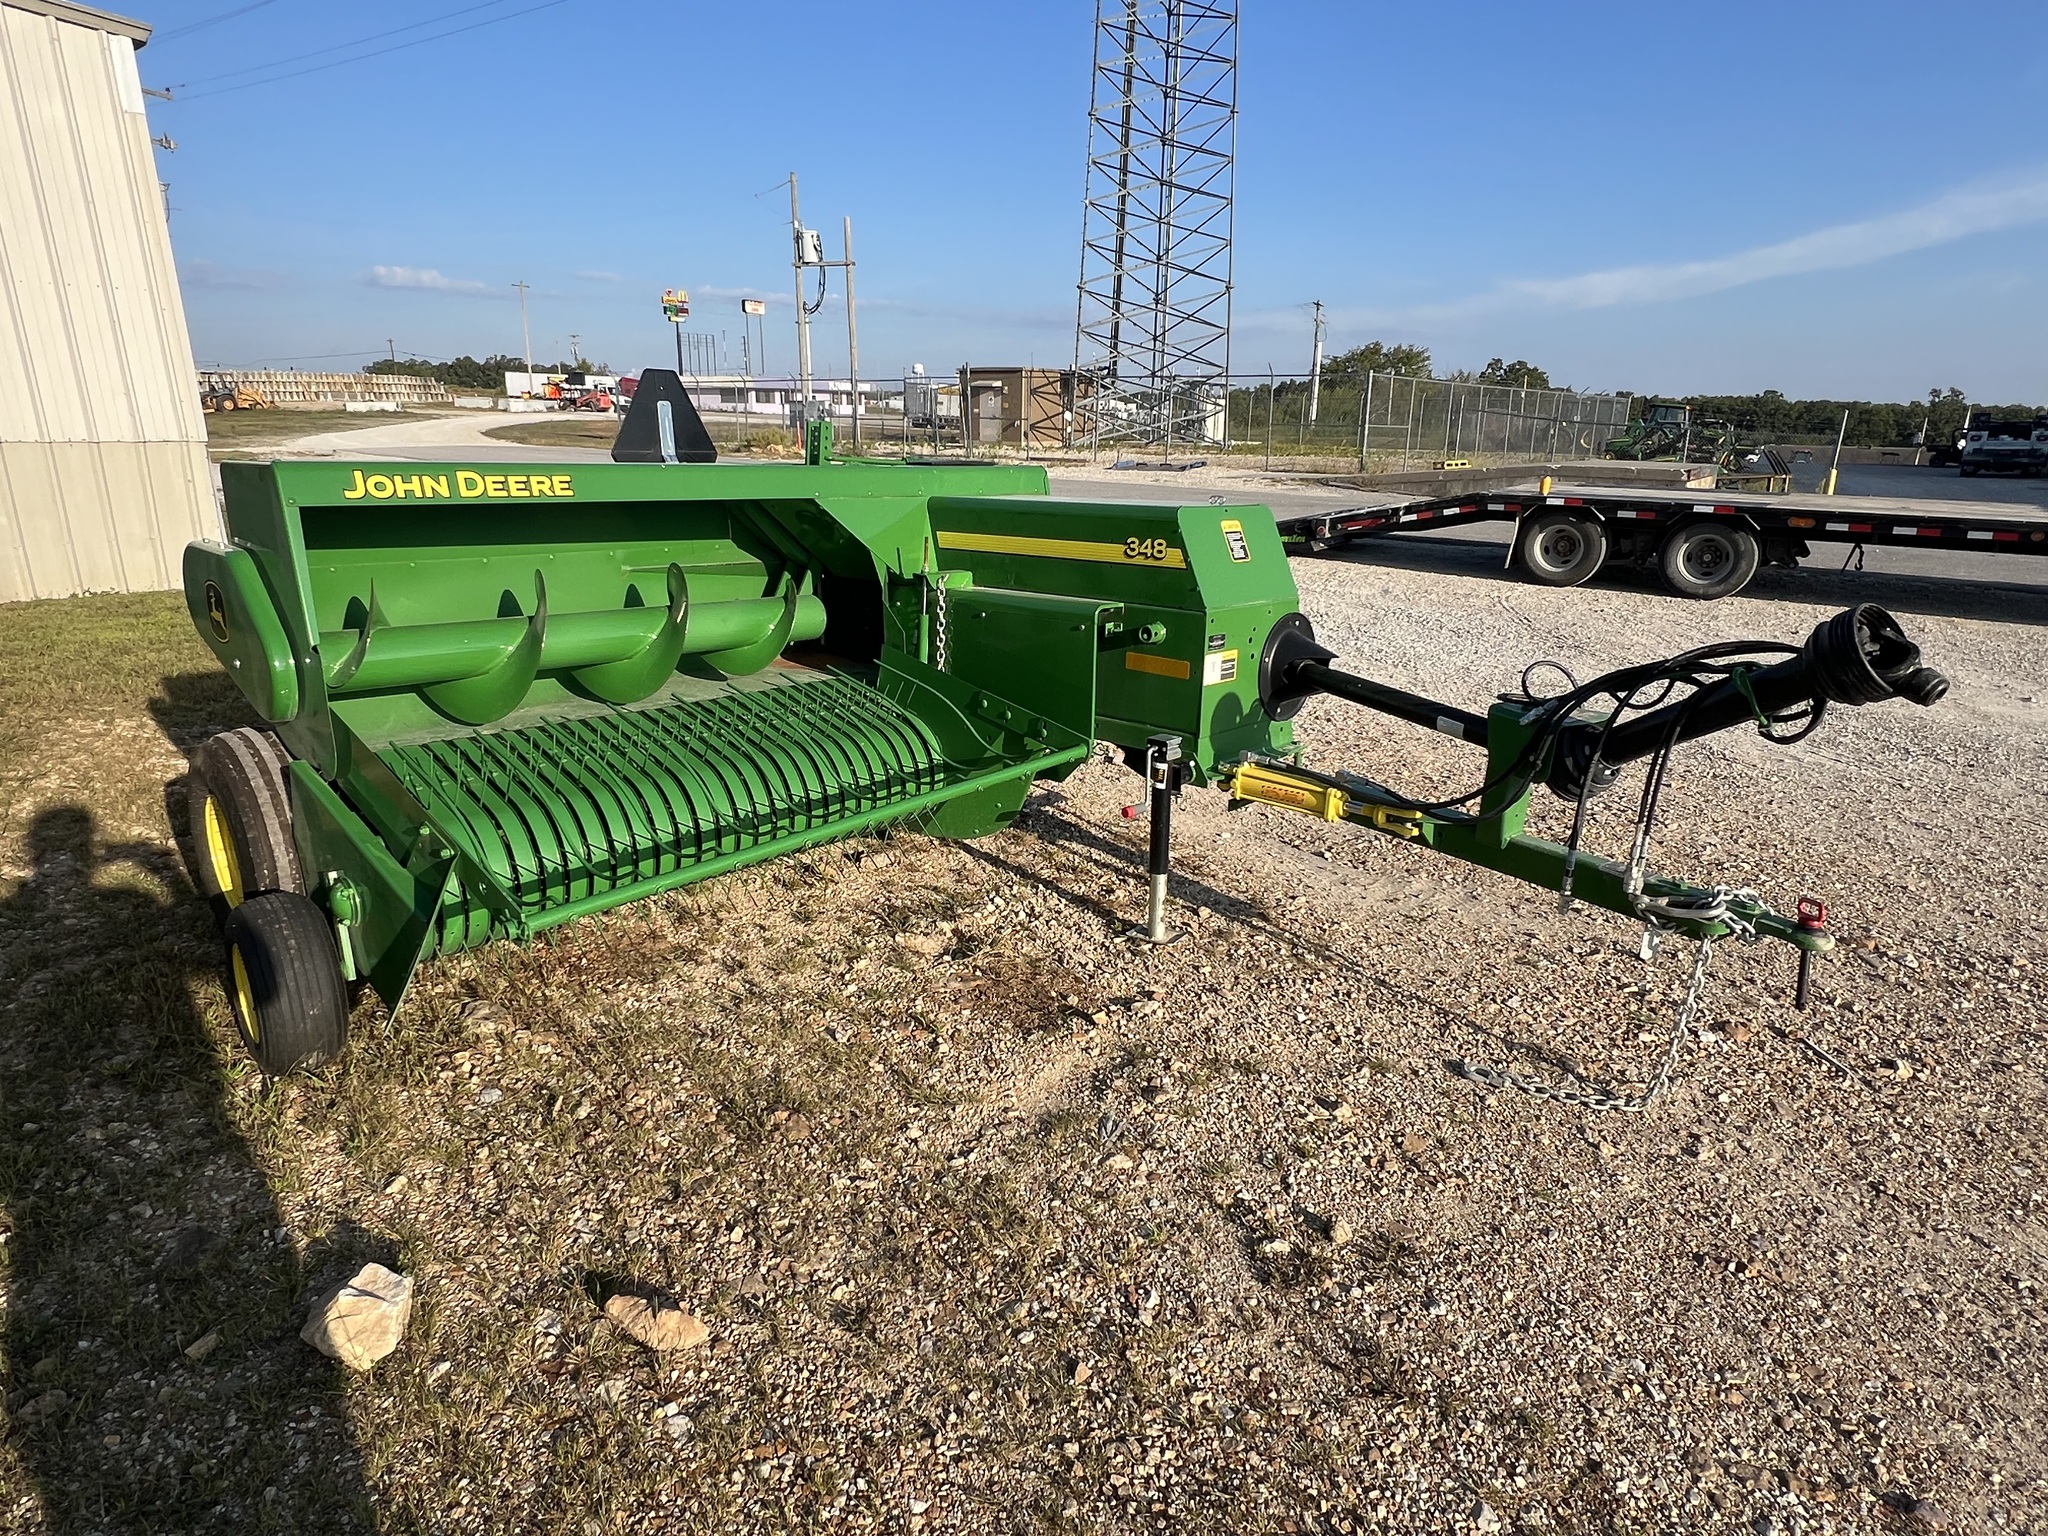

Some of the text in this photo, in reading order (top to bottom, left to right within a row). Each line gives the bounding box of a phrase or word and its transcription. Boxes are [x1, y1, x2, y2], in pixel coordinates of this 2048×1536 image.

[343, 469, 575, 499] JOHN DEERE
[1124, 536, 1167, 559] 348
